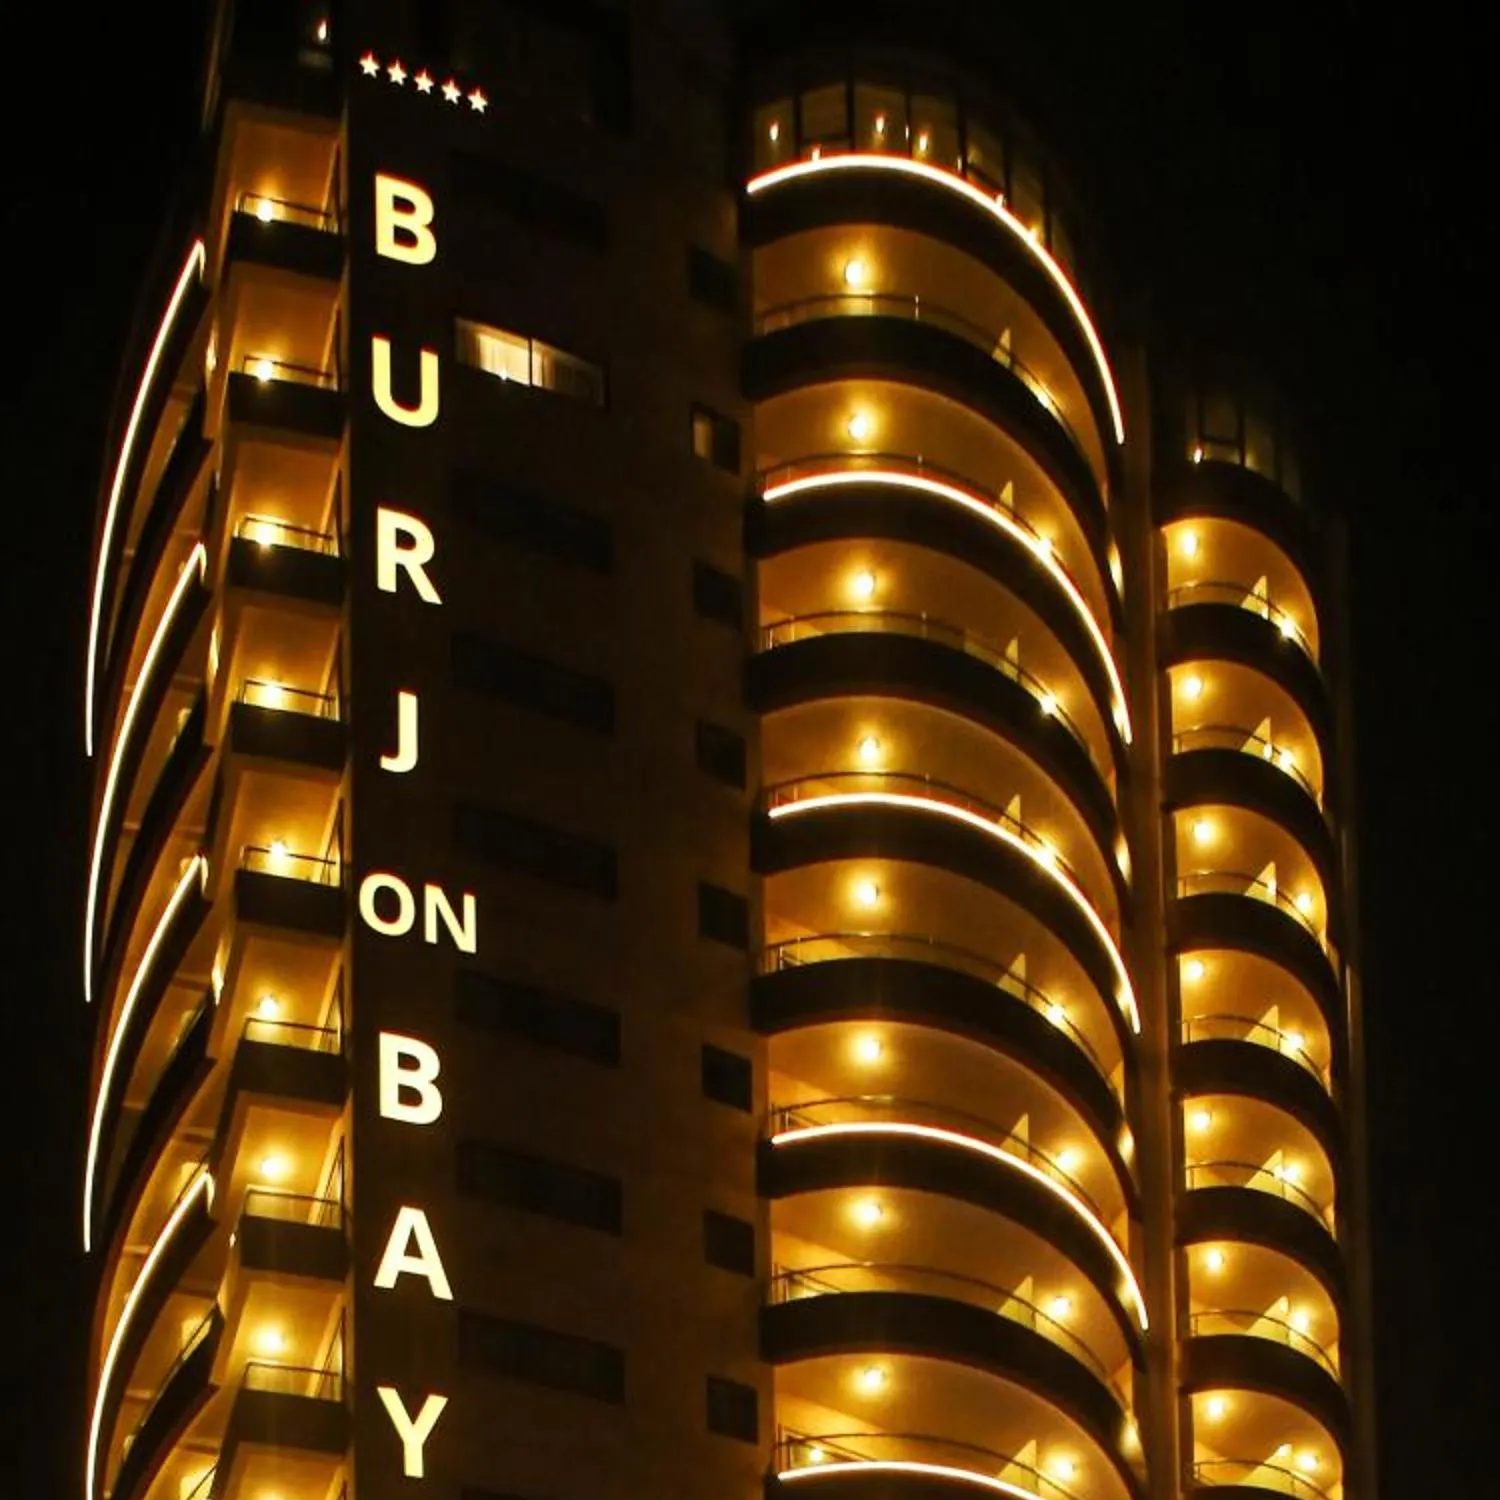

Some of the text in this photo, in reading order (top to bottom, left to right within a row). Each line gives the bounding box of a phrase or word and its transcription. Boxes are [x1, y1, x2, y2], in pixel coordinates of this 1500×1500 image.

[358, 173, 478, 1478] BURJ ON BAY
